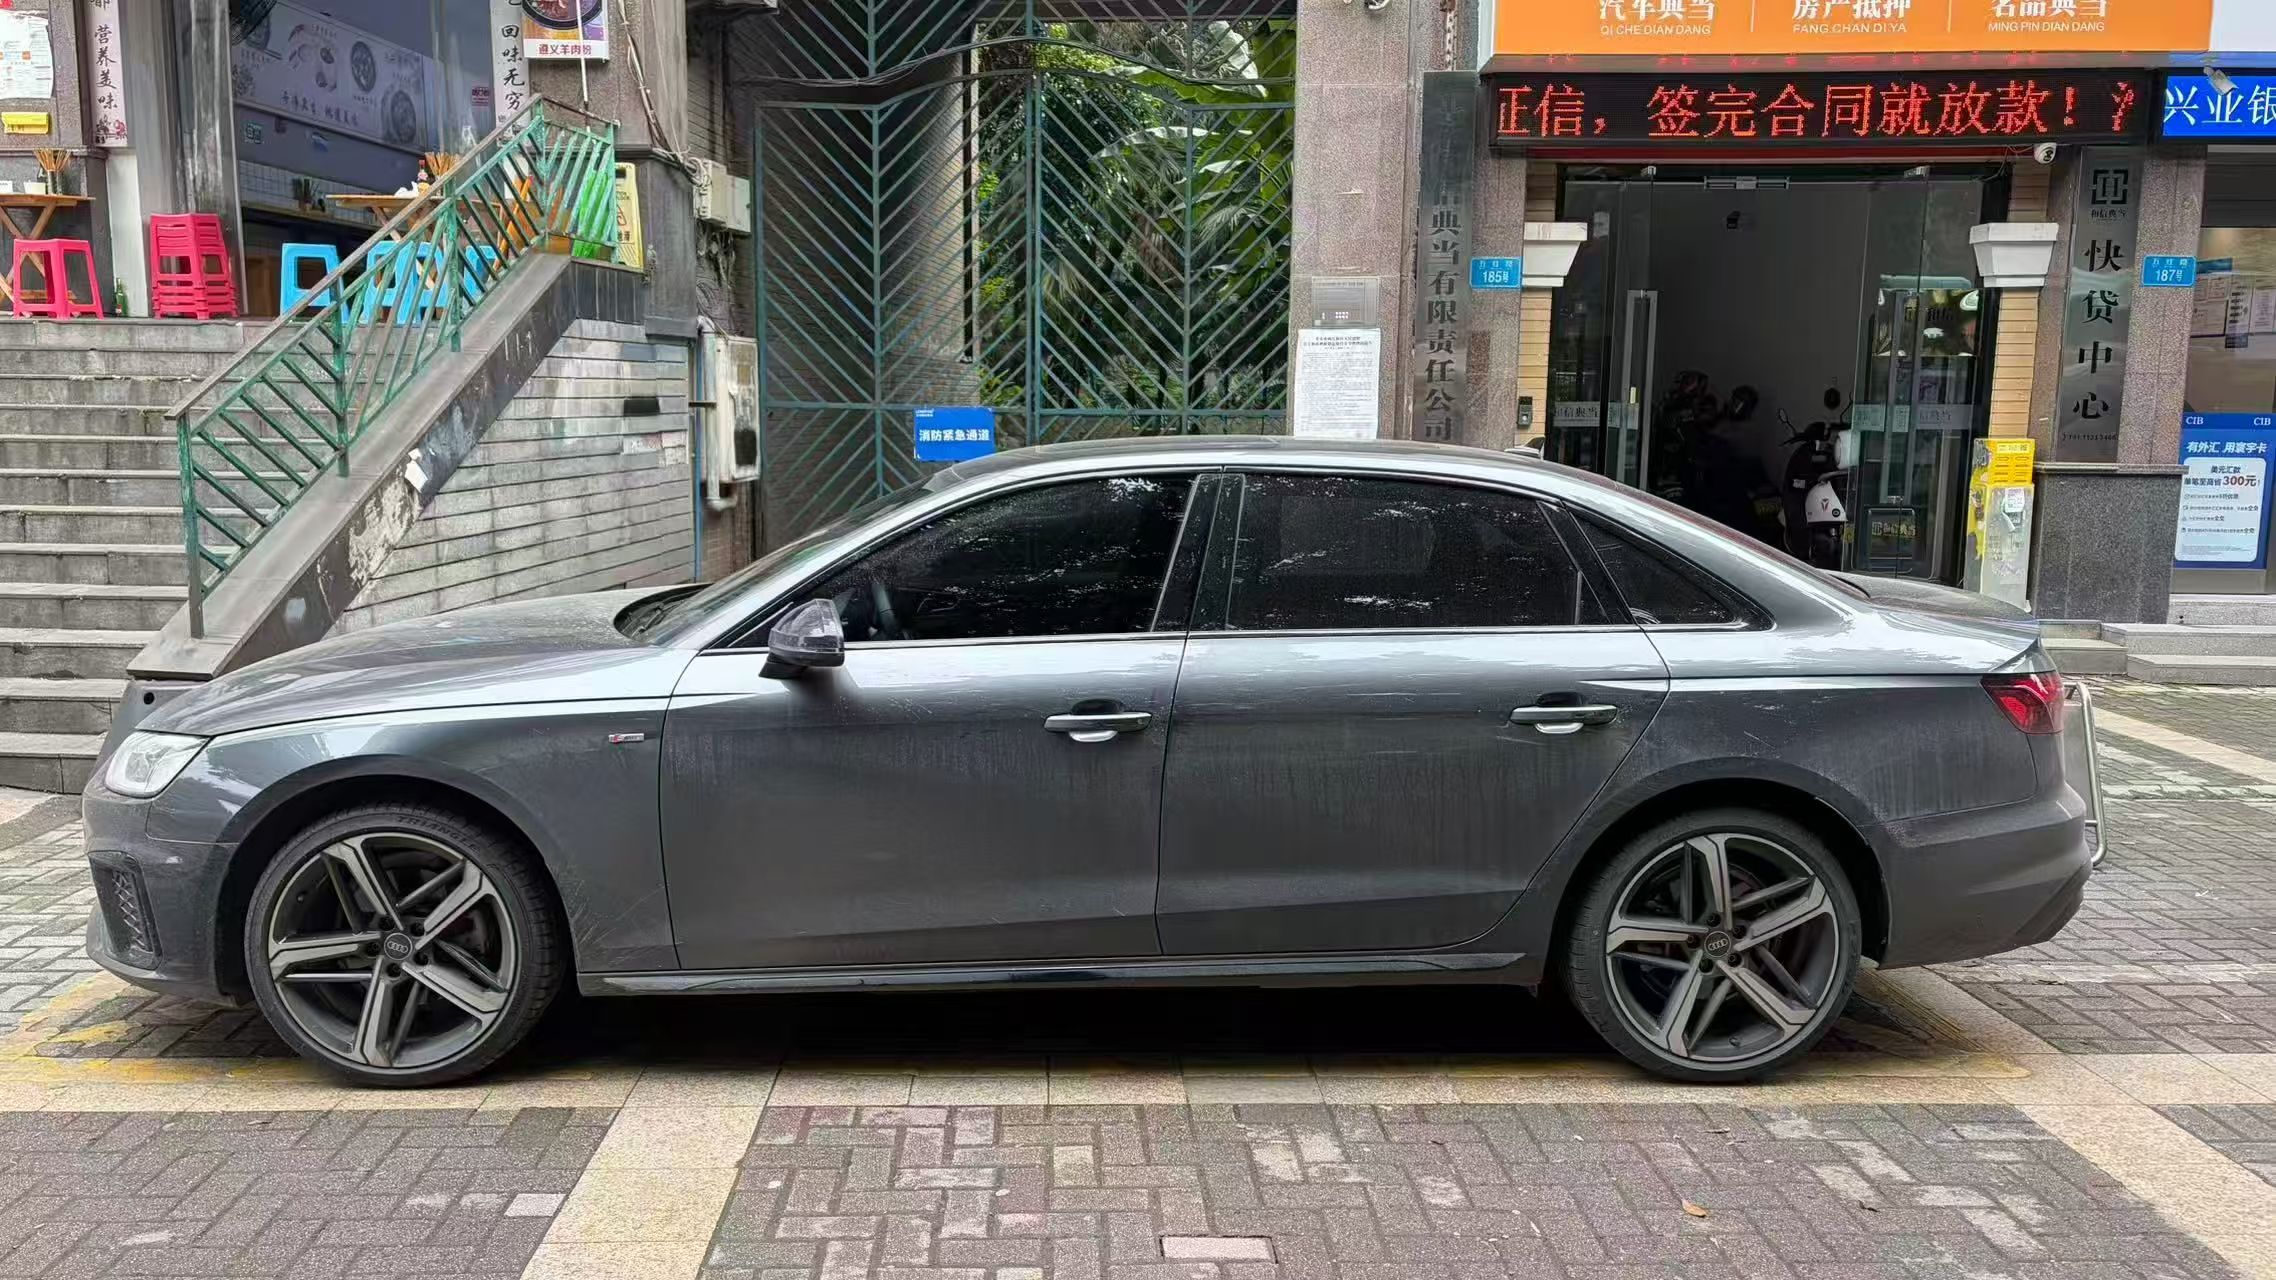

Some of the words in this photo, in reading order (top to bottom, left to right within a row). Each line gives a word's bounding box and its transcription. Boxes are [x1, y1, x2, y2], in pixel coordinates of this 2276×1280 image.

[1600, 0, 1715, 20] 汽车典当
[1792, 0, 1911, 19] 房产抵押
[1990, 0, 2107, 17] 名品典当
[1616, 25, 1641, 35] CHE
[1643, 25, 1674, 35] DIAN
[1676, 25, 1711, 35] DANG
[1793, 24, 1829, 33] FANG
[1832, 24, 1870, 33] CHAN
[1988, 22, 2018, 32] MING
[2020, 22, 2040, 32] PIN
[2042, 21, 2070, 31] DIAN
[2071, 21, 2105, 31] DANG
[538, 43, 593, 56] 遵义羊肉粉
[2164, 83, 2276, 127] 兴业银
[1482, 270, 1510, 283] 185号
[2155, 269, 2184, 282] 187号
[2073, 239, 2125, 420] 快贷中心
[2185, 416, 2204, 425] CIB
[2253, 417, 2272, 426] CIB
[919, 429, 990, 442] 消防紧急通道
[2186, 441, 2221, 453] 有外汇
